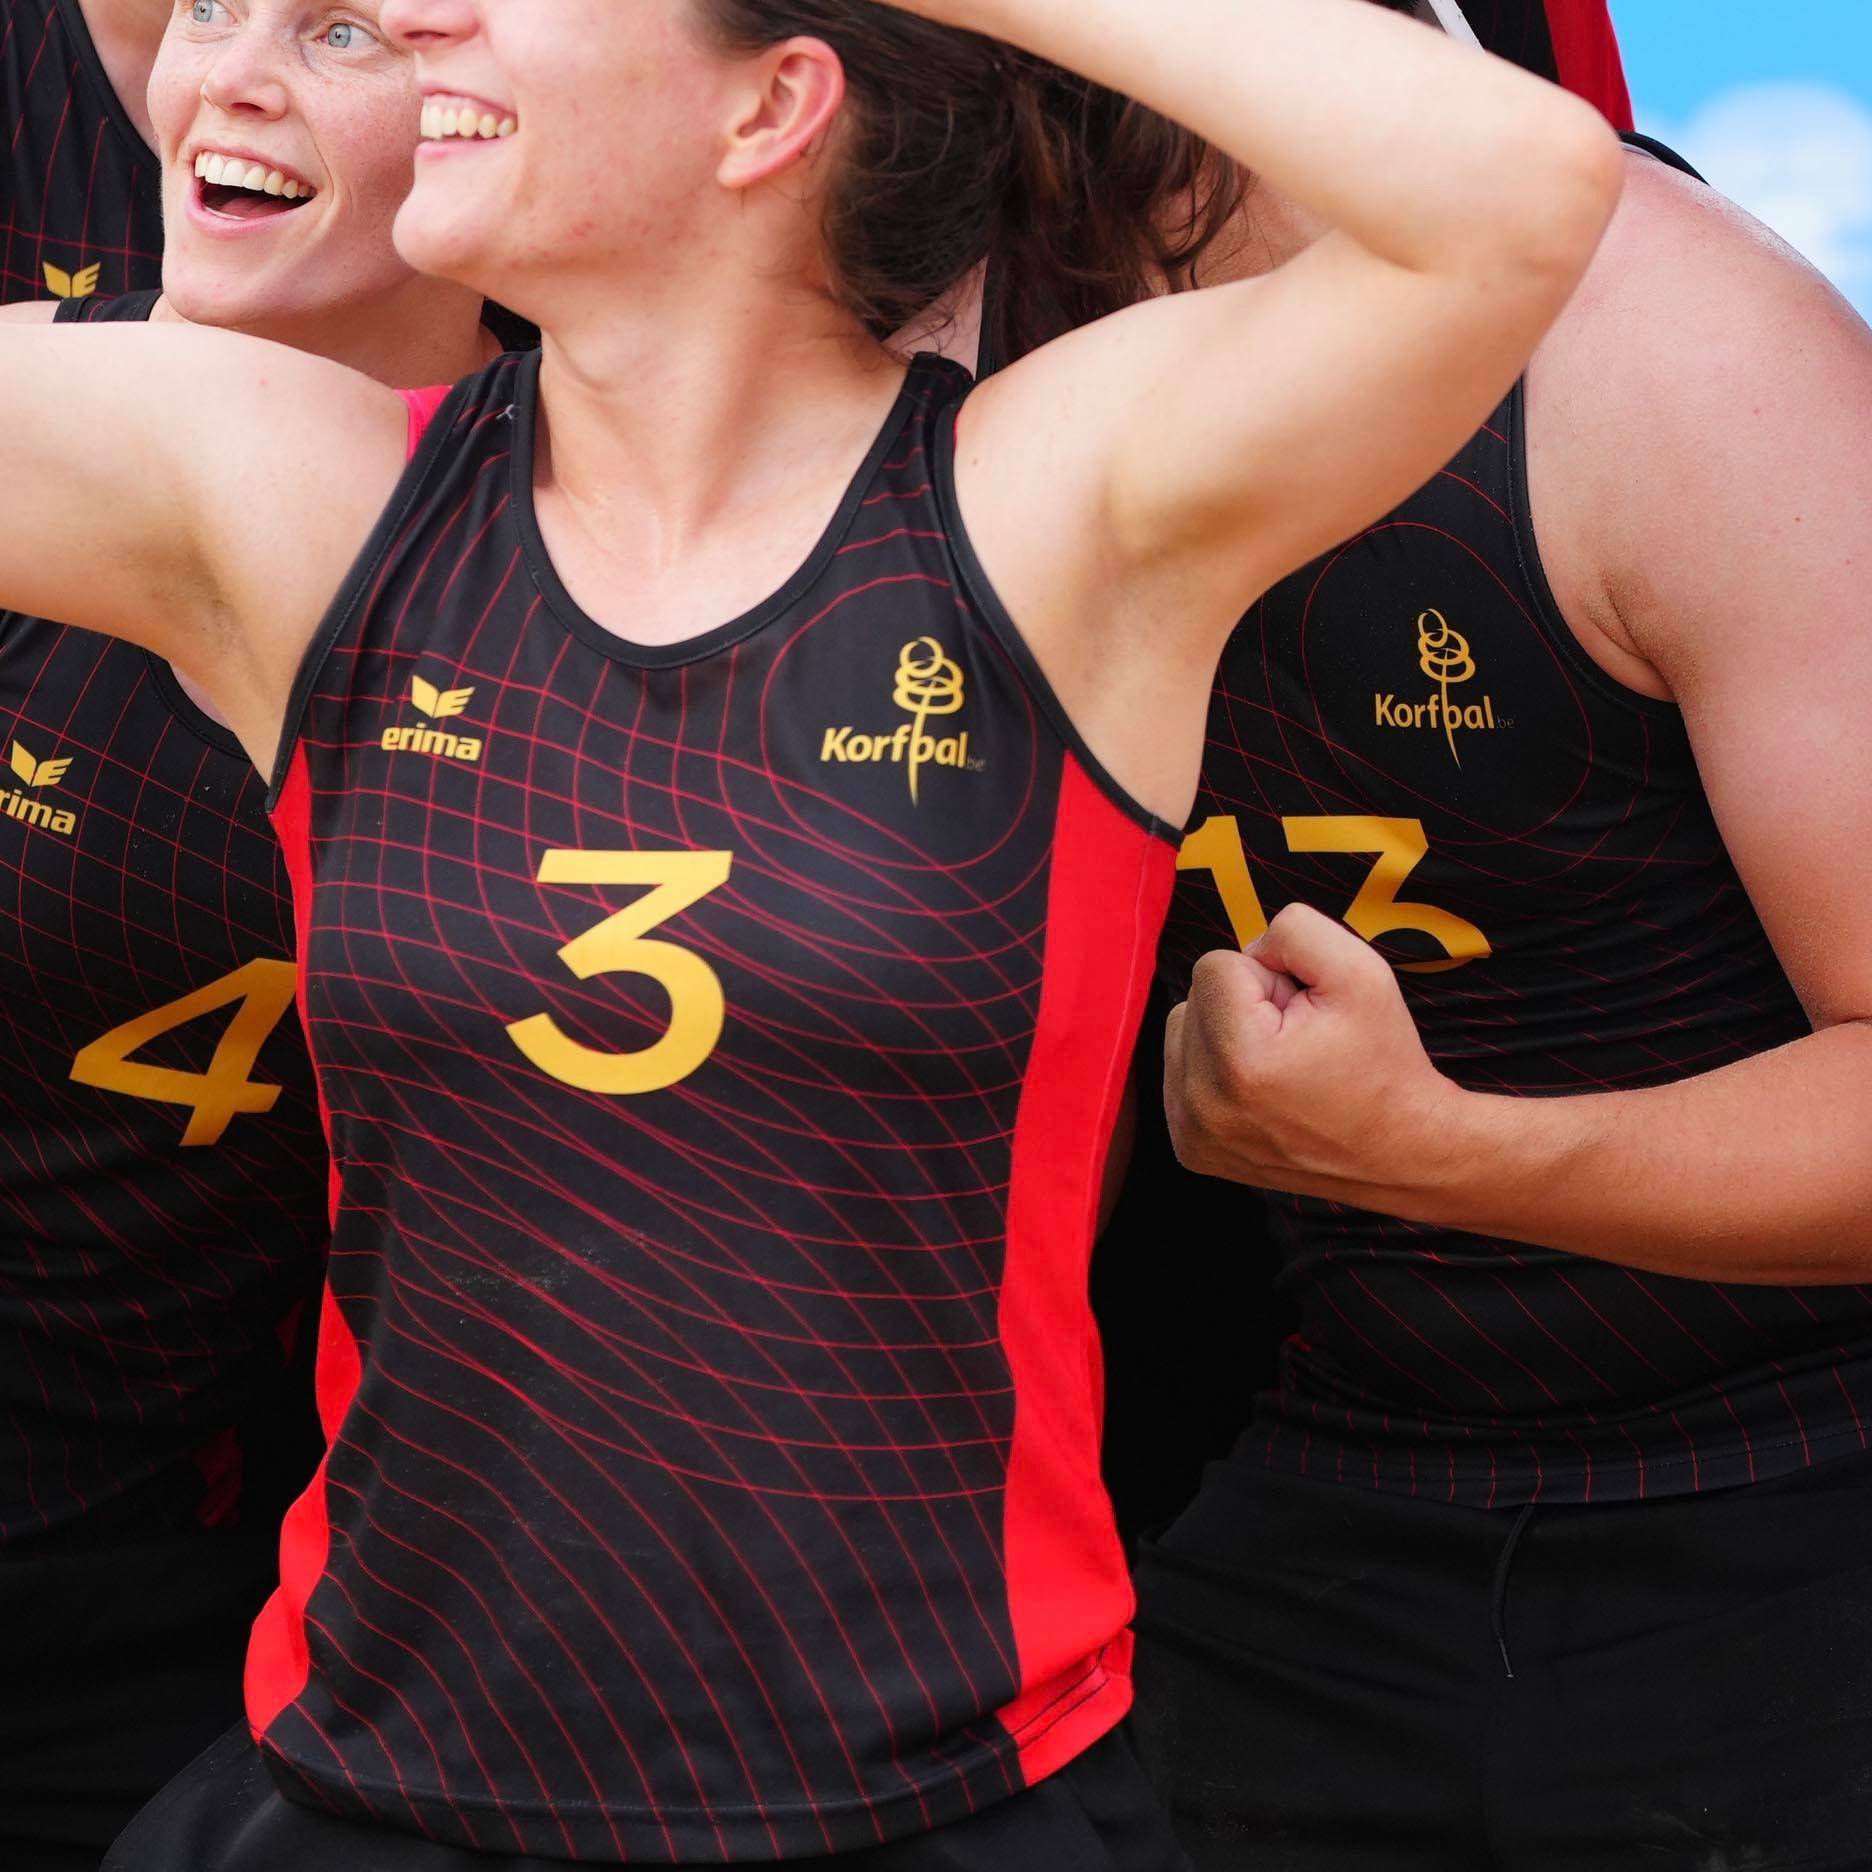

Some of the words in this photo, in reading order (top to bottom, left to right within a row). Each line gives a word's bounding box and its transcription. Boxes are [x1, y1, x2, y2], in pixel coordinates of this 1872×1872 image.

[381, 722, 481, 763] erima
[505, 848, 734, 1096] 3
[1176, 815, 1493, 973] 13
[68, 956, 298, 1147] 4
